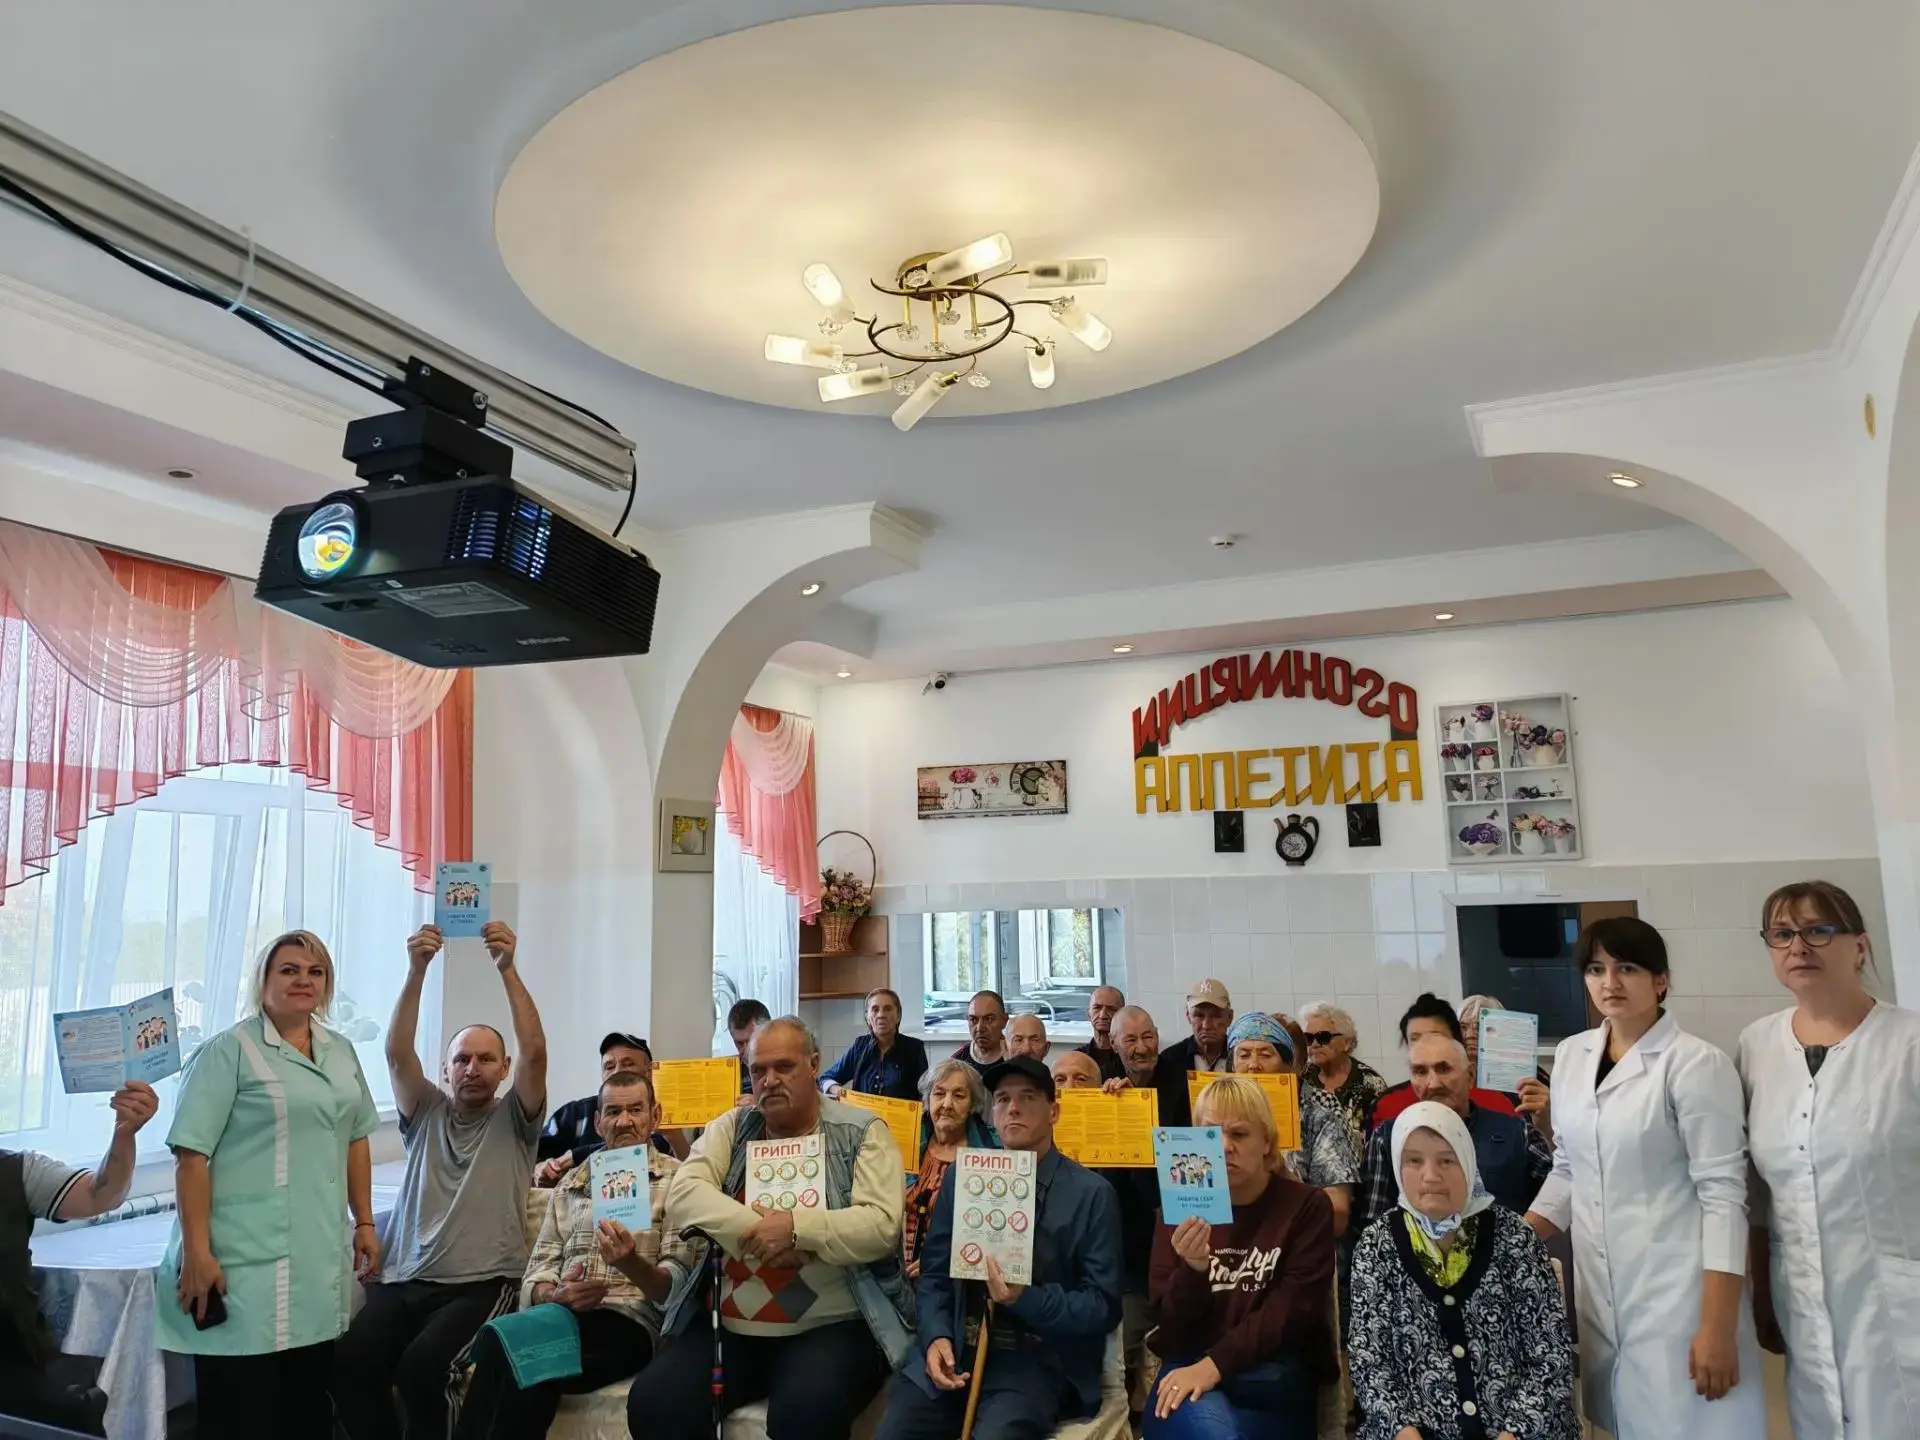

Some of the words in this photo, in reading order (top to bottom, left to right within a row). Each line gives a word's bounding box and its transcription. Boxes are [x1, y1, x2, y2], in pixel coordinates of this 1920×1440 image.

[1134, 739, 1424, 815] АППЕТИТА
[754, 1143, 801, 1158] ГРИПП
[964, 1154, 1012, 1170] ГРИПП
